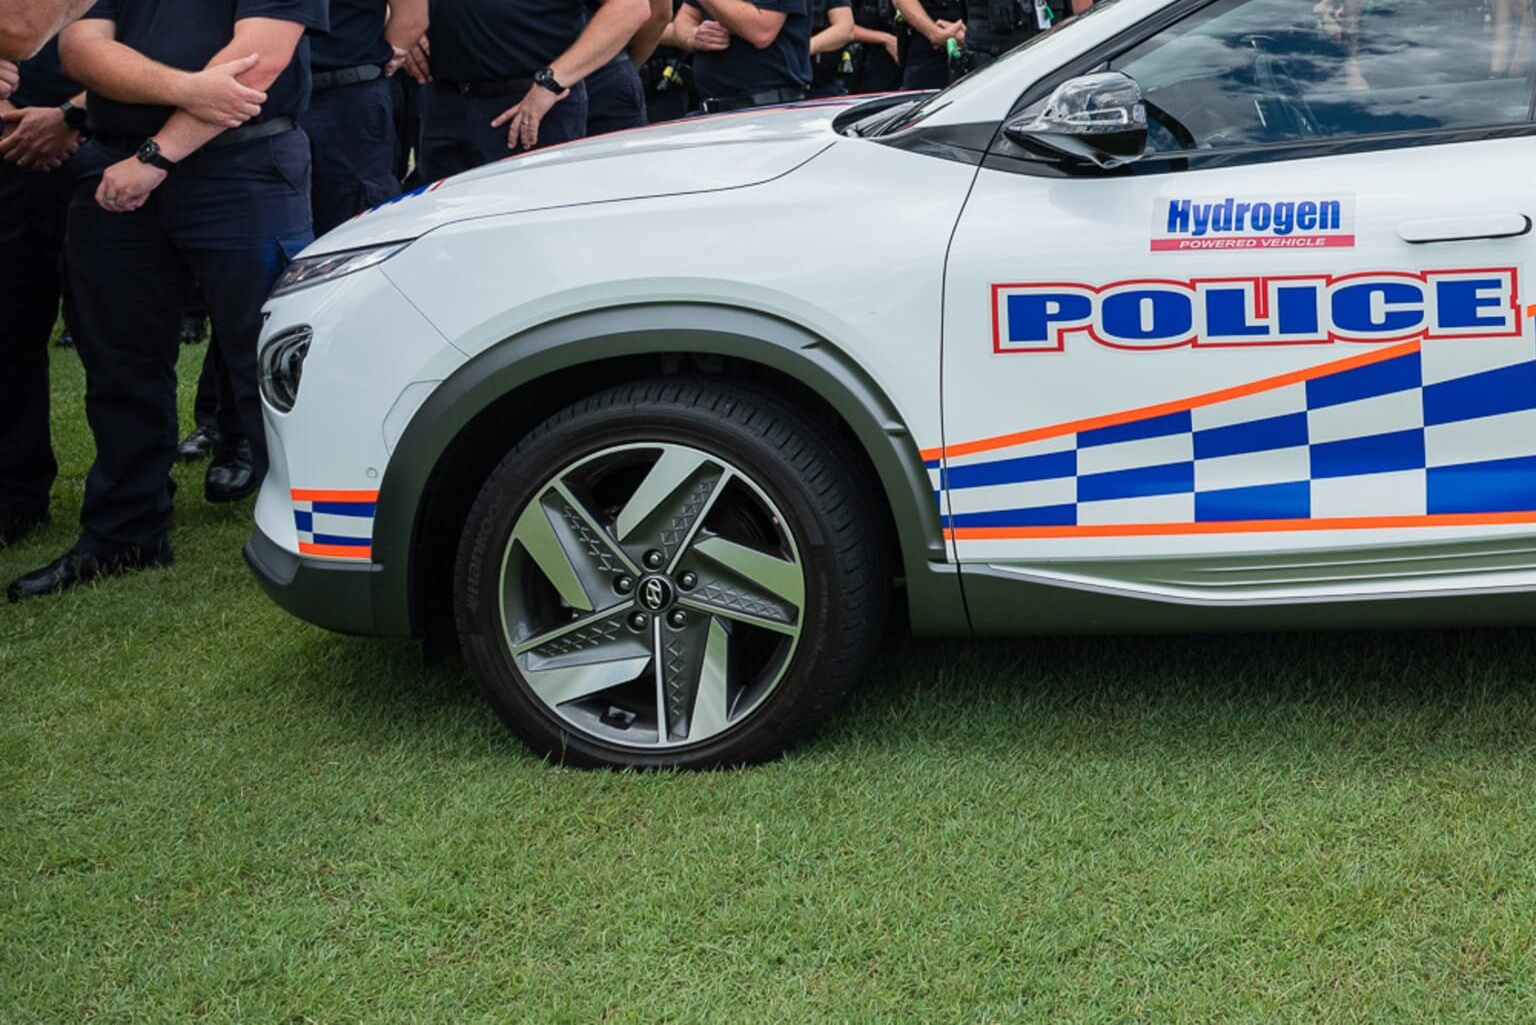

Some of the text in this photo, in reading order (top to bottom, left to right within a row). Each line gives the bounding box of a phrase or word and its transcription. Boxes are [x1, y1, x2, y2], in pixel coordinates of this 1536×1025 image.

[1166, 197, 1341, 236] Hydrogen
[1178, 237, 1327, 249] POWERED VEHICLE
[1005, 277, 1507, 342] POLICE
